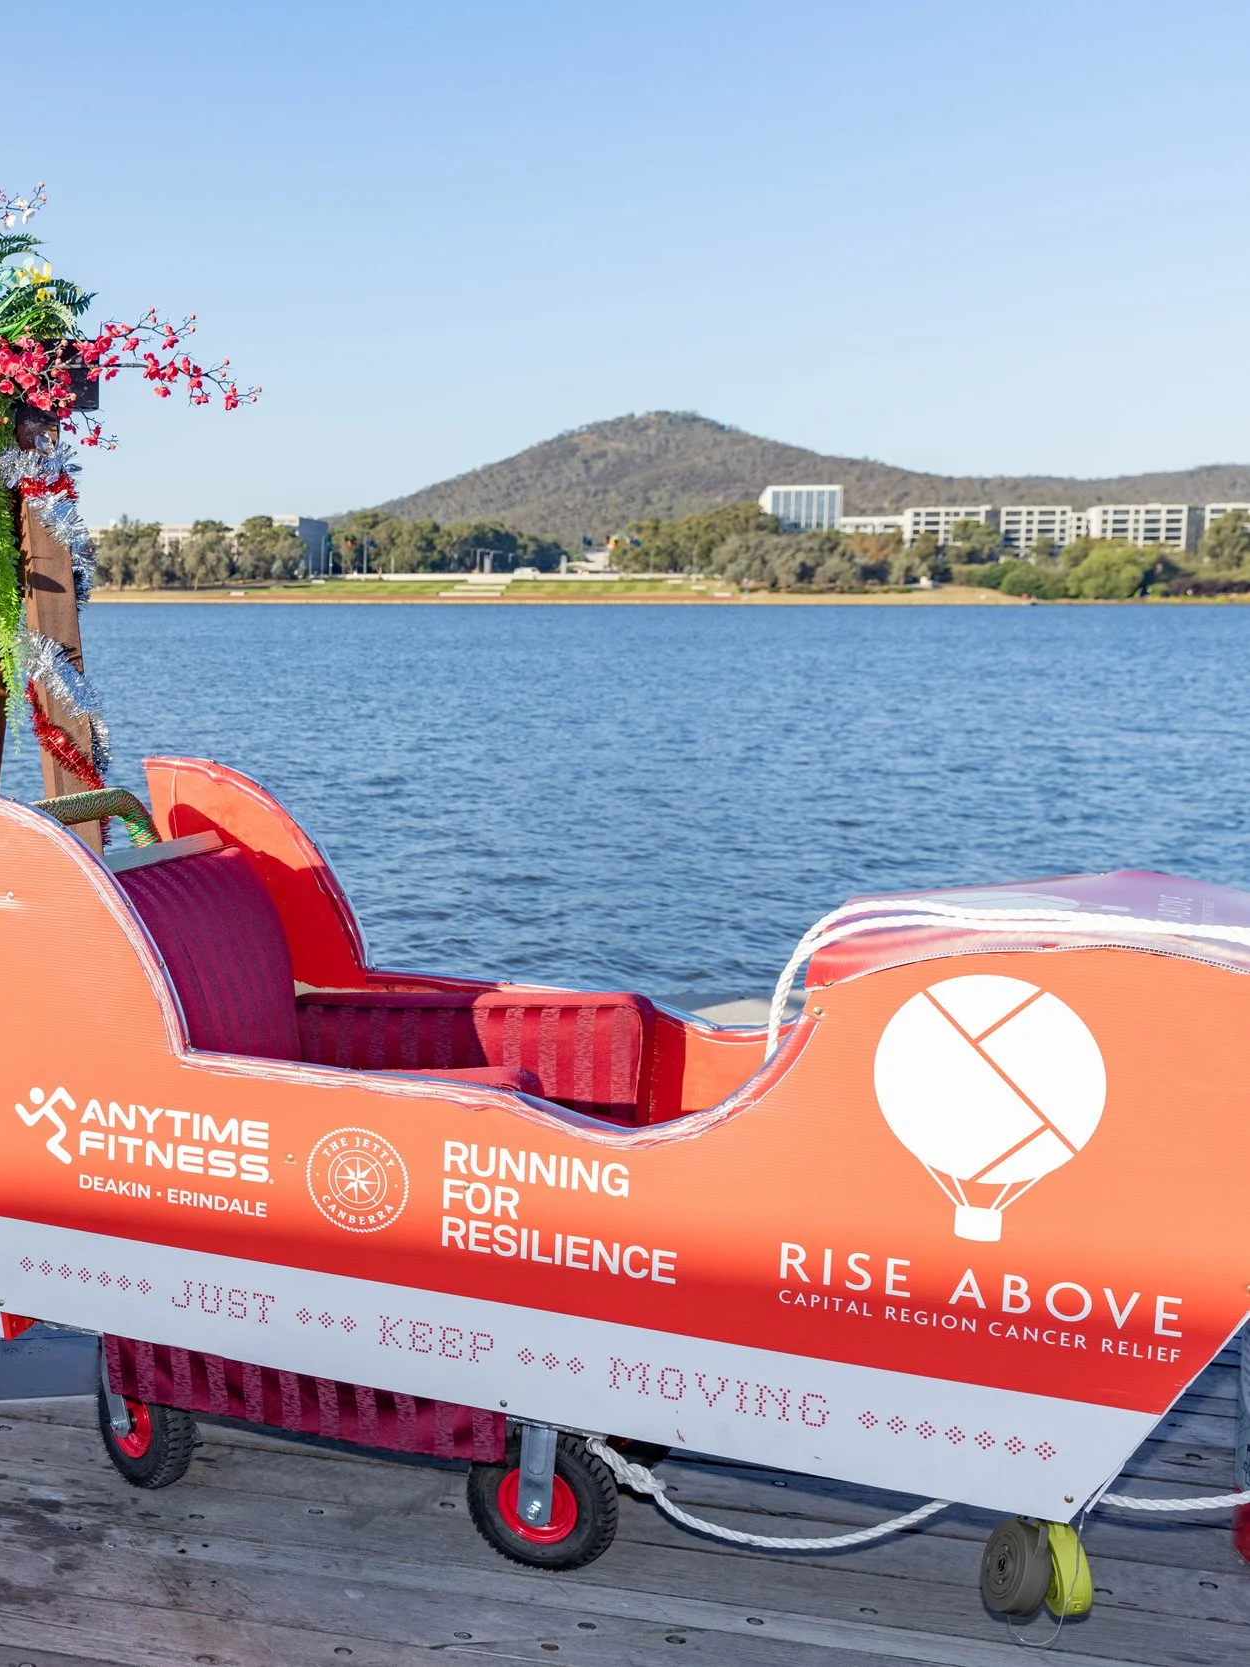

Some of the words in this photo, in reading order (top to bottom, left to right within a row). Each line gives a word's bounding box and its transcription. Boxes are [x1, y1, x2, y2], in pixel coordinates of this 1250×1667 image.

[80, 1098, 269, 1150] ANYTIME
[79, 1130, 271, 1184] FITNESS
[322, 1137, 348, 1157] THE
[354, 1136, 395, 1168] JETTY
[443, 1140, 630, 1198] RUNNING
[79, 1173, 151, 1200] DEAKIN
[167, 1187, 268, 1218] ERINDALE
[322, 1195, 394, 1226] CANBERRA
[442, 1178, 520, 1220] FOR
[441, 1215, 677, 1285] RESILIENCE
[779, 1242, 911, 1298] RISE
[948, 1267, 1183, 1338] ABOVE
[778, 1289, 873, 1318] CAPITAL
[884, 1305, 977, 1333] REGION
[988, 1321, 1087, 1350] CANCER
[1101, 1338, 1181, 1364] RELIEF
[171, 1280, 275, 1324] JUST
[379, 1314, 494, 1363] KEEP
[608, 1356, 830, 1428] MOVING
